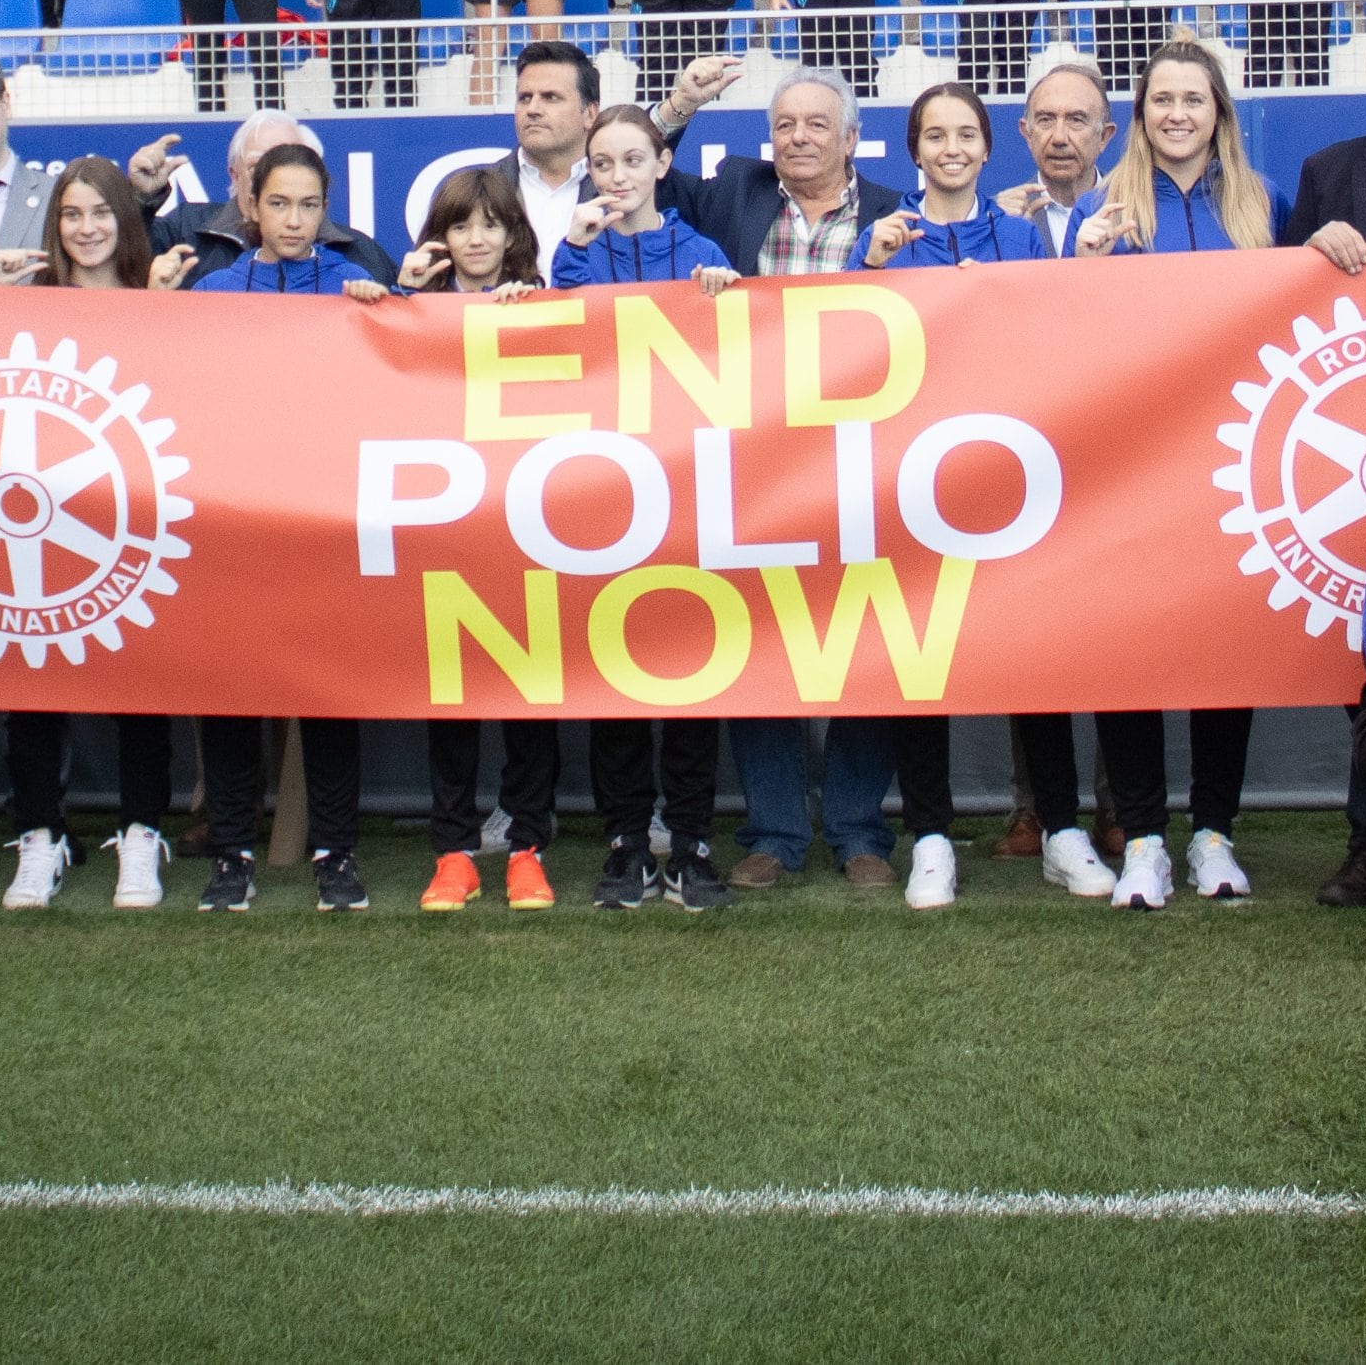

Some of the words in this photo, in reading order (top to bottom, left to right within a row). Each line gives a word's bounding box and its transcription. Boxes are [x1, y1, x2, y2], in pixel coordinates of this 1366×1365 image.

[463, 284, 926, 441] END
[356, 413, 1063, 577] POLIO
[422, 557, 978, 706] NOW
